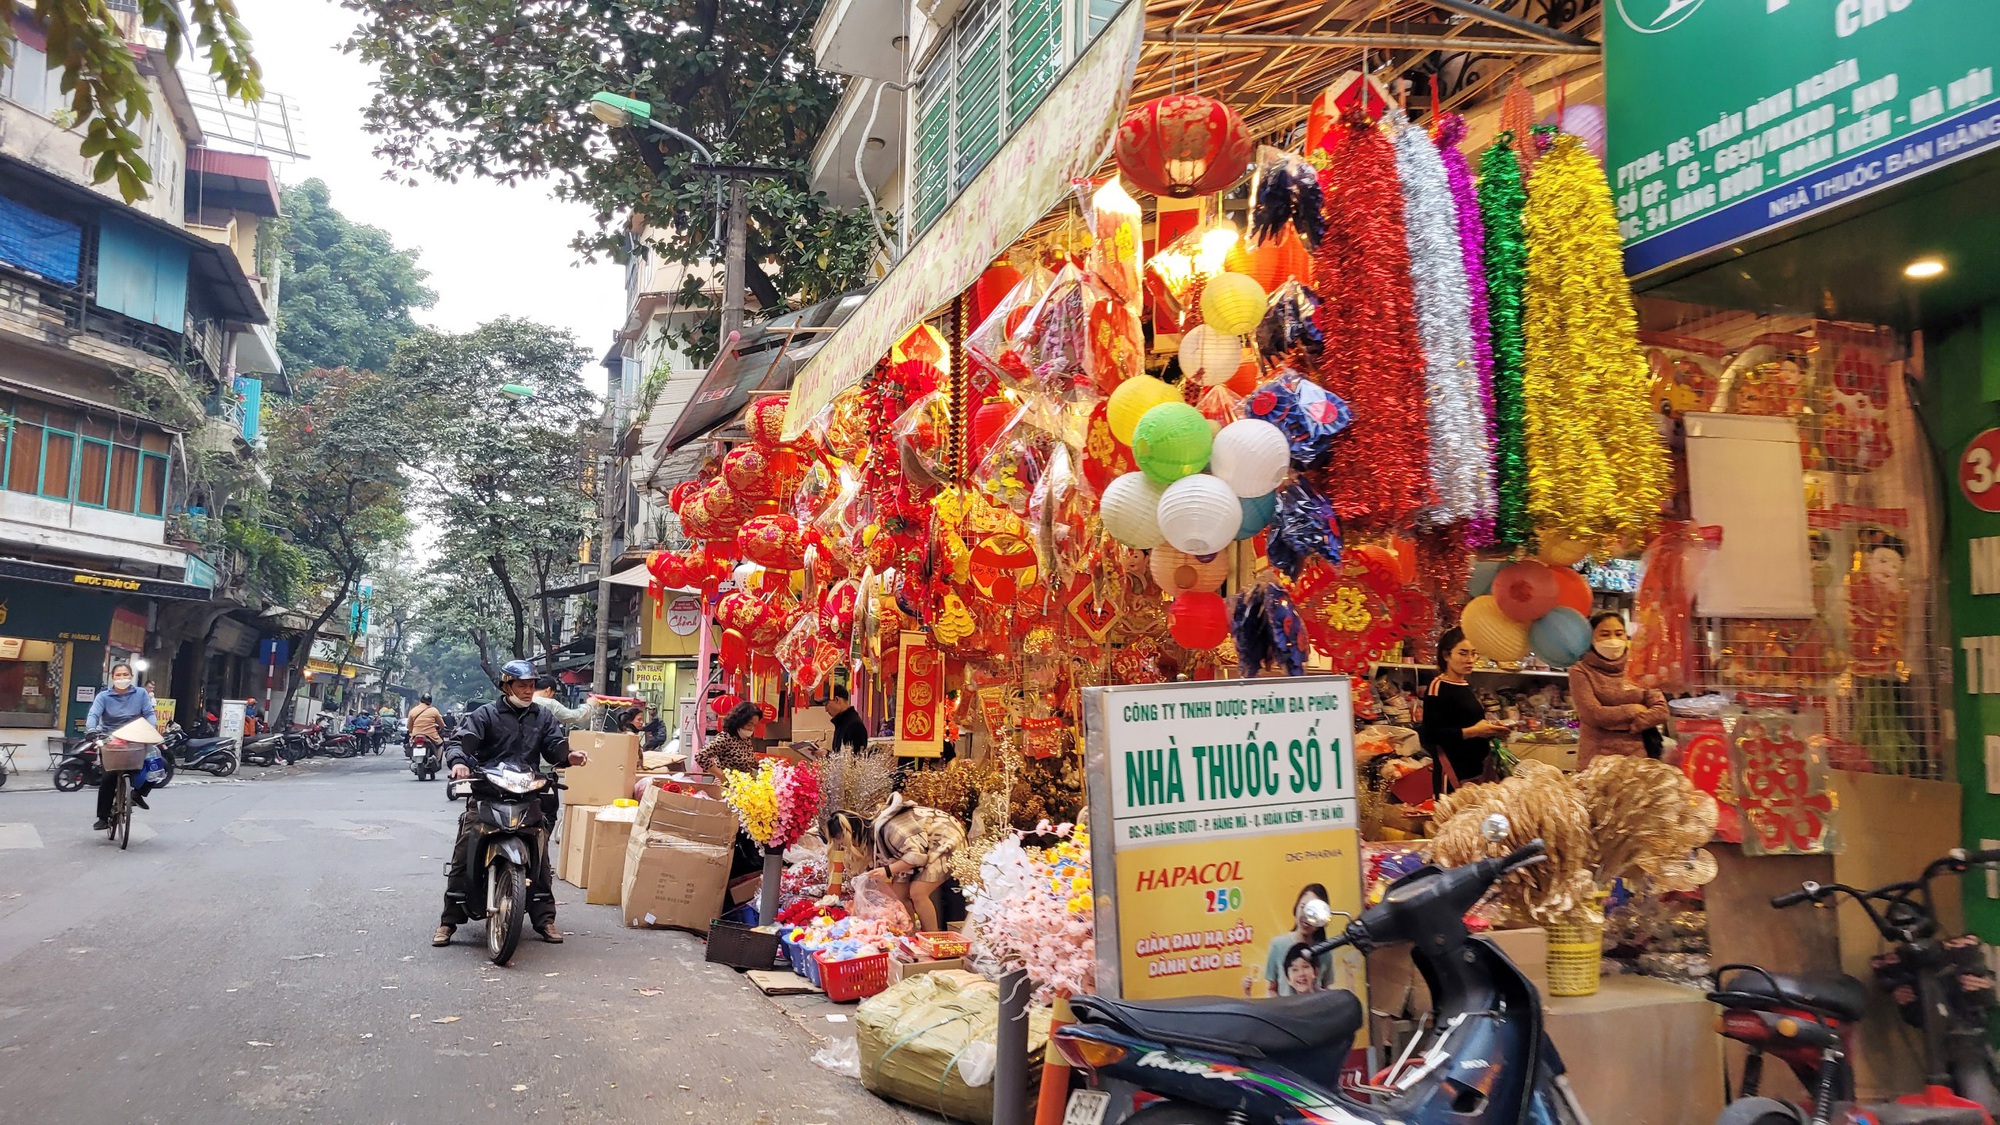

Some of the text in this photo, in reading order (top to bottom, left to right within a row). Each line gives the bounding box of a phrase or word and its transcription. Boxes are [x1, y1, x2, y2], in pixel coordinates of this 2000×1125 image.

[1696, 111, 1743, 152] TRẦN
[1646, 203, 1667, 231] 34
[1670, 183, 1716, 222] HÀNG
[1909, 86, 1945, 125] HÀ
[1947, 67, 1993, 110] NỘI
[1677, 160, 1700, 190] 03
[1768, 114, 2000, 219] NHÀ THUỐC BÁN HÀNG
[1123, 702, 1158, 723] CÔNG
[1161, 703, 1176, 720] TY
[1179, 701, 1212, 719] TNHH
[1215, 699, 1247, 720] DƯỢC
[1251, 691, 1286, 716] PHẨM
[1125, 718, 1342, 808] NHÀ THUỐC SỐ 1
[1143, 824, 1153, 838] 34
[1155, 820, 1176, 836] HÀNG
[1213, 815, 1234, 831] HÀNG
[1263, 809, 1283, 826] HOÀN
[1320, 805, 1330, 821] HÀ
[1305, 848, 1343, 860] PHARMA
[1135, 860, 1244, 893] HAPACOL
[1204, 887, 1242, 914] 250
[1136, 918, 1253, 957] GIẢM ĐAU HẠ SỐT
[1148, 955, 1187, 978] DÀNH
[1190, 953, 1221, 973] CHO
